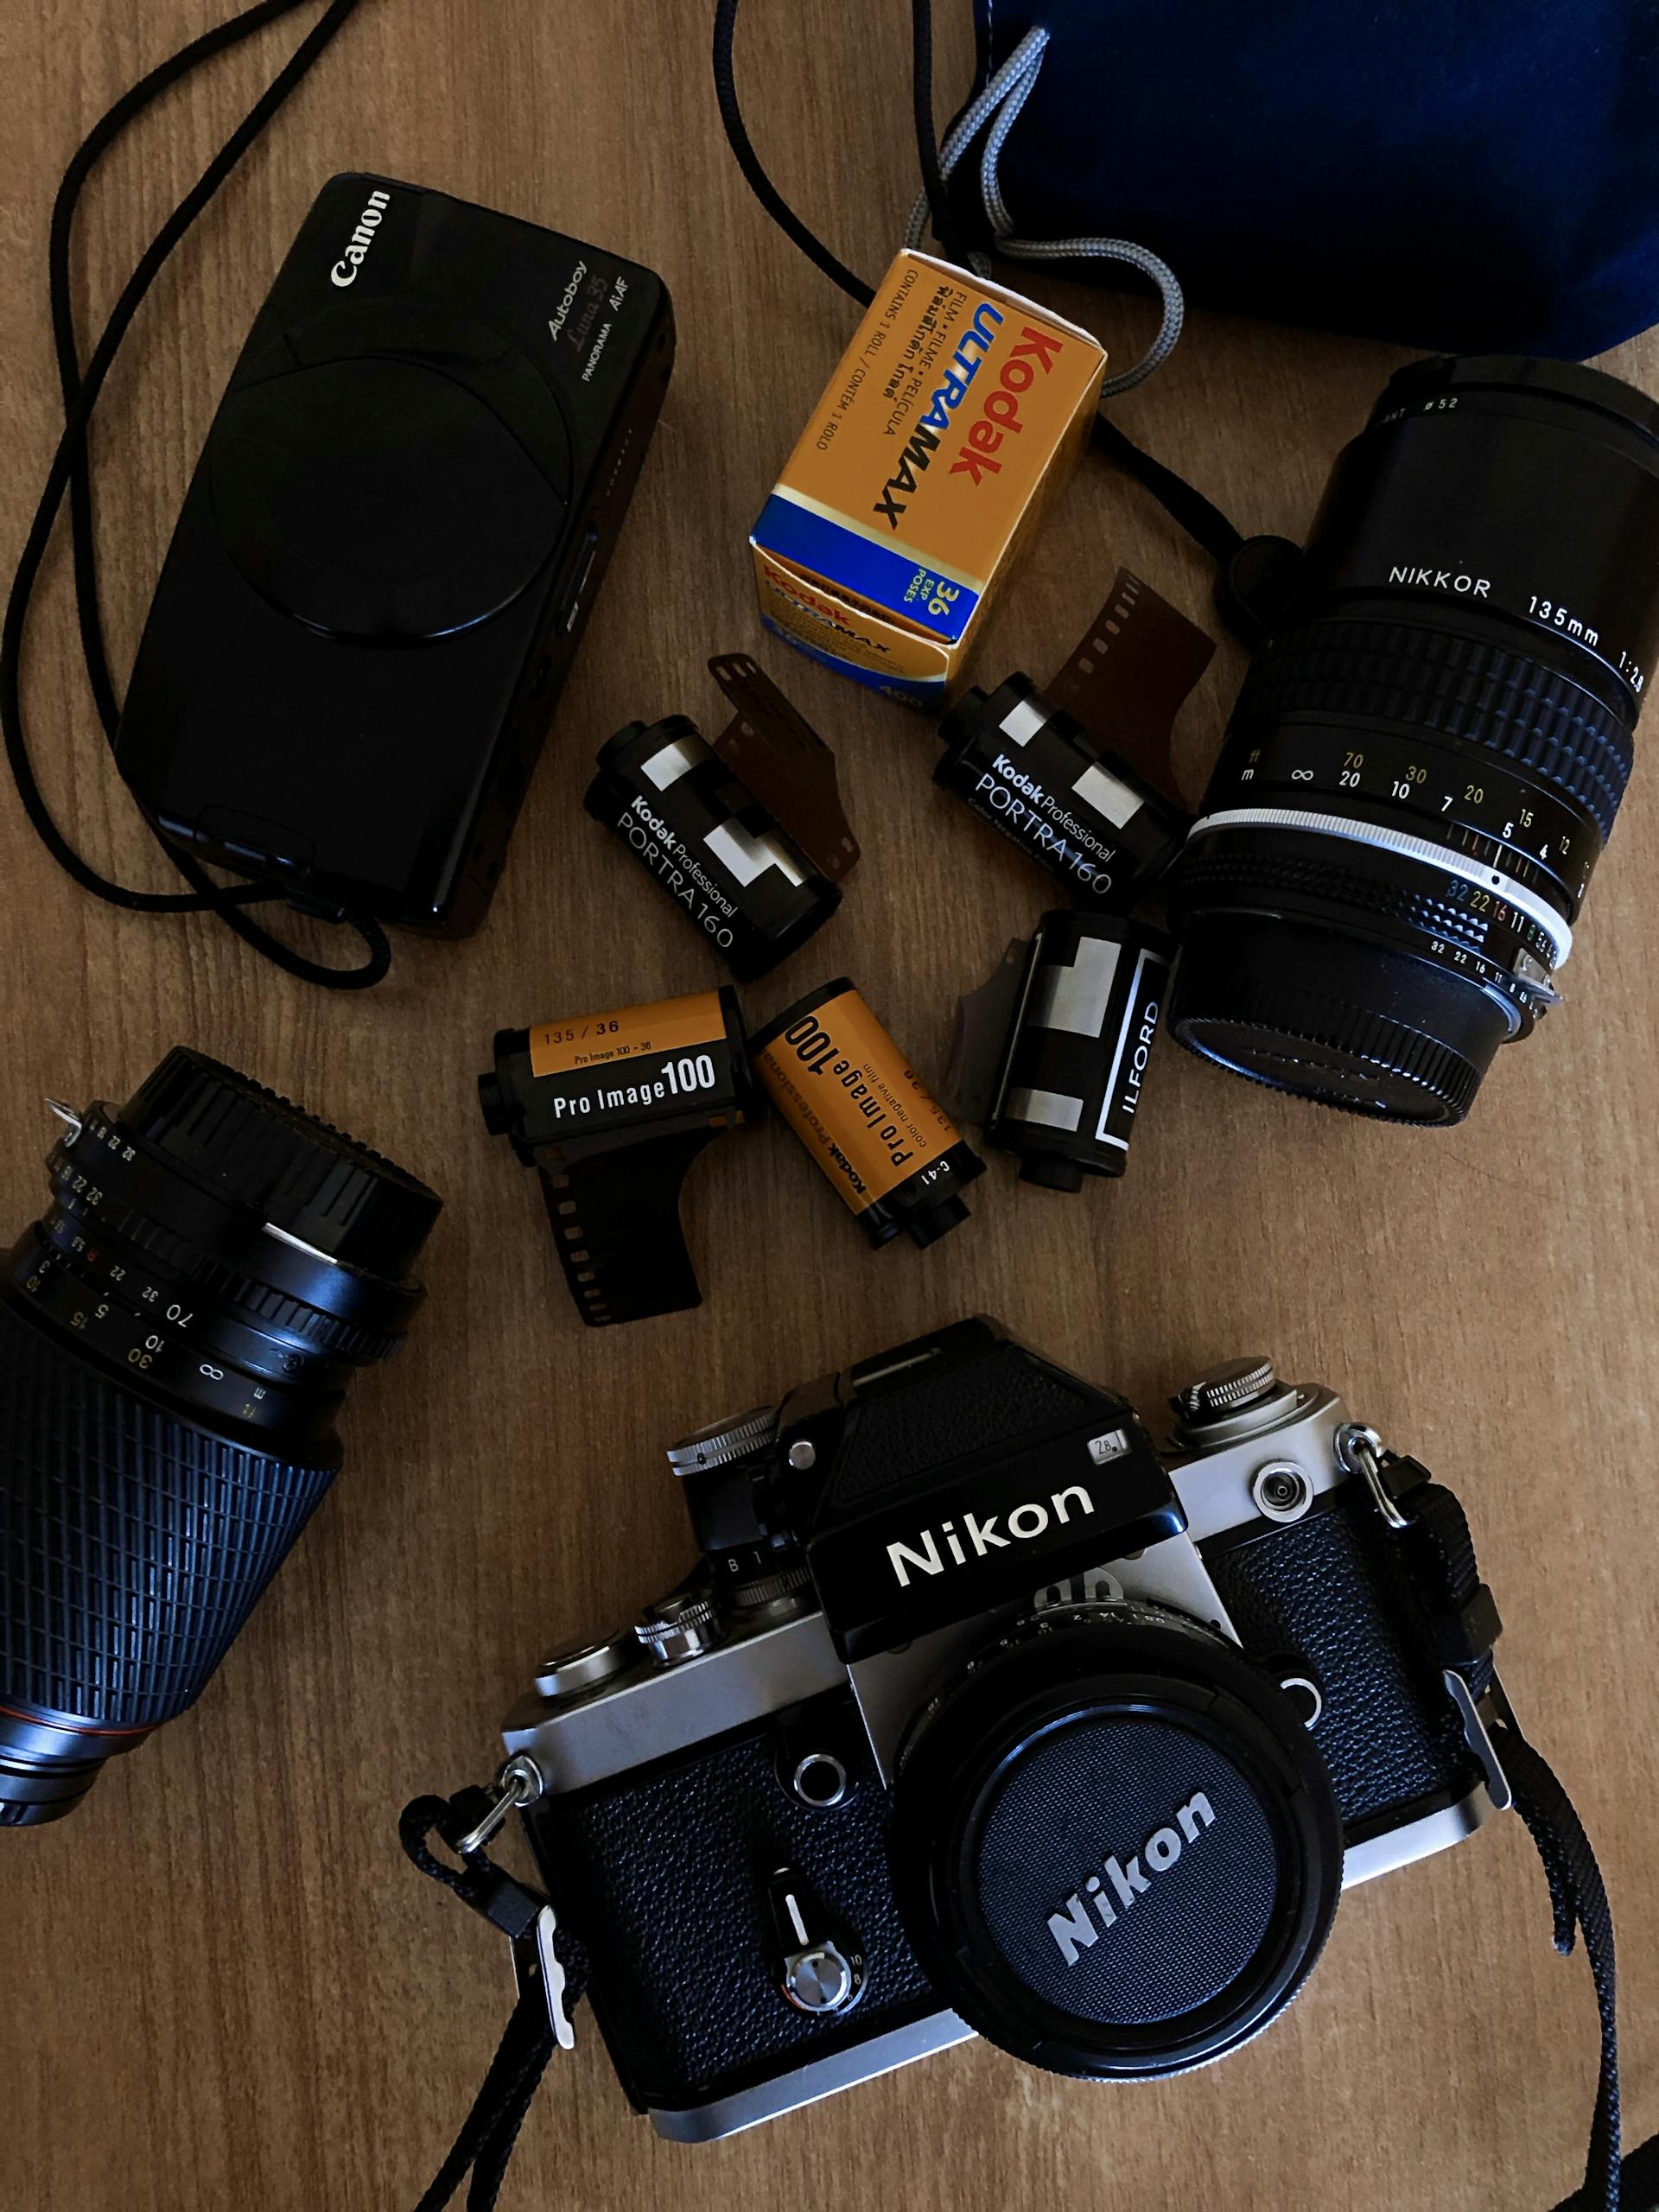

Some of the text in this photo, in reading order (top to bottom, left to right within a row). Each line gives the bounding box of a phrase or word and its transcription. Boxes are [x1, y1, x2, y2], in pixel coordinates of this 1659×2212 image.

[330, 189, 392, 288] Canon
[546, 260, 588, 342] Autoboy
[880, 269, 919, 321] CONTAINS
[582, 322, 613, 383] PANORAMA
[865, 331, 887, 359] ROLL
[882, 290, 968, 436] FILM FILME PELÍCULA
[841, 368, 867, 413] CONTÉM
[949, 326, 1064, 486] Kodak
[874, 302, 1005, 531] ULTRAMAX
[816, 422, 840, 451] ROLO
[764, 563, 851, 626] Kodak
[903, 568, 926, 603] POSES
[918, 578, 935, 602] EXP
[927, 581, 960, 617] 36
[1389, 566, 1491, 598] NIKKOR
[1529, 595, 1599, 646] 135mm
[991, 753, 1117, 863] Kodak Professional
[1241, 768, 1255, 781] m
[1338, 770, 1362, 788] 20
[1389, 781, 1410, 799] 10
[1440, 795, 1454, 812] 7
[1503, 822, 1515, 839] 5
[1539, 843, 1549, 861] 4
[1343, 752, 1364, 768] 70
[1405, 766, 1427, 784] 30
[1464, 785, 1485, 804] 20
[1518, 808, 1535, 828] 15
[1559, 836, 1570, 855] 12
[975, 772, 1112, 894] PORTRA 160
[630, 794, 740, 918] Kodak Professional
[616, 811, 734, 948] PORTRA 160
[1446, 879, 1469, 902] 32
[1469, 890, 1491, 912] 22
[1492, 900, 1508, 922] 16
[1510, 912, 1524, 933] 11
[1431, 940, 1446, 954] 32
[1453, 950, 1467, 964] 22
[1476, 961, 1485, 974] 16
[1495, 972, 1503, 983] 11
[544, 1029, 575, 1046] 135
[595, 1020, 620, 1036] 36
[574, 1055, 589, 1065] Pro
[589, 1049, 614, 1064] Image
[615, 1045, 631, 1056] 100
[1122, 1001, 1159, 1114] ILFORD
[553, 1096, 591, 1119] Pro
[863, 1063, 927, 1148] color negative film
[880, 1125, 914, 1166] Pro
[72, 1175, 87, 1193] 22
[828, 1142, 867, 1195] Kodak
[920, 1160, 950, 1185] C-41
[86, 1186, 104, 1205] 32
[25, 1274, 42, 1294] 10
[38, 1259, 52, 1274] 3
[110, 1265, 127, 1281] 22
[94, 1303, 111, 1320] 5
[142, 1286, 159, 1303] 32
[69, 1310, 88, 1331] 15
[166, 1303, 194, 1329] 70
[127, 1347, 154, 1370] 30
[145, 1334, 166, 1354] 10
[253, 1386, 267, 1400] m
[886, 1484, 1096, 1588] Nikon
[728, 1558, 739, 1572] B
[1046, 1790, 1217, 1967] Nikon
[850, 1954, 862, 1967] 10
[854, 1973, 861, 1986] 8
